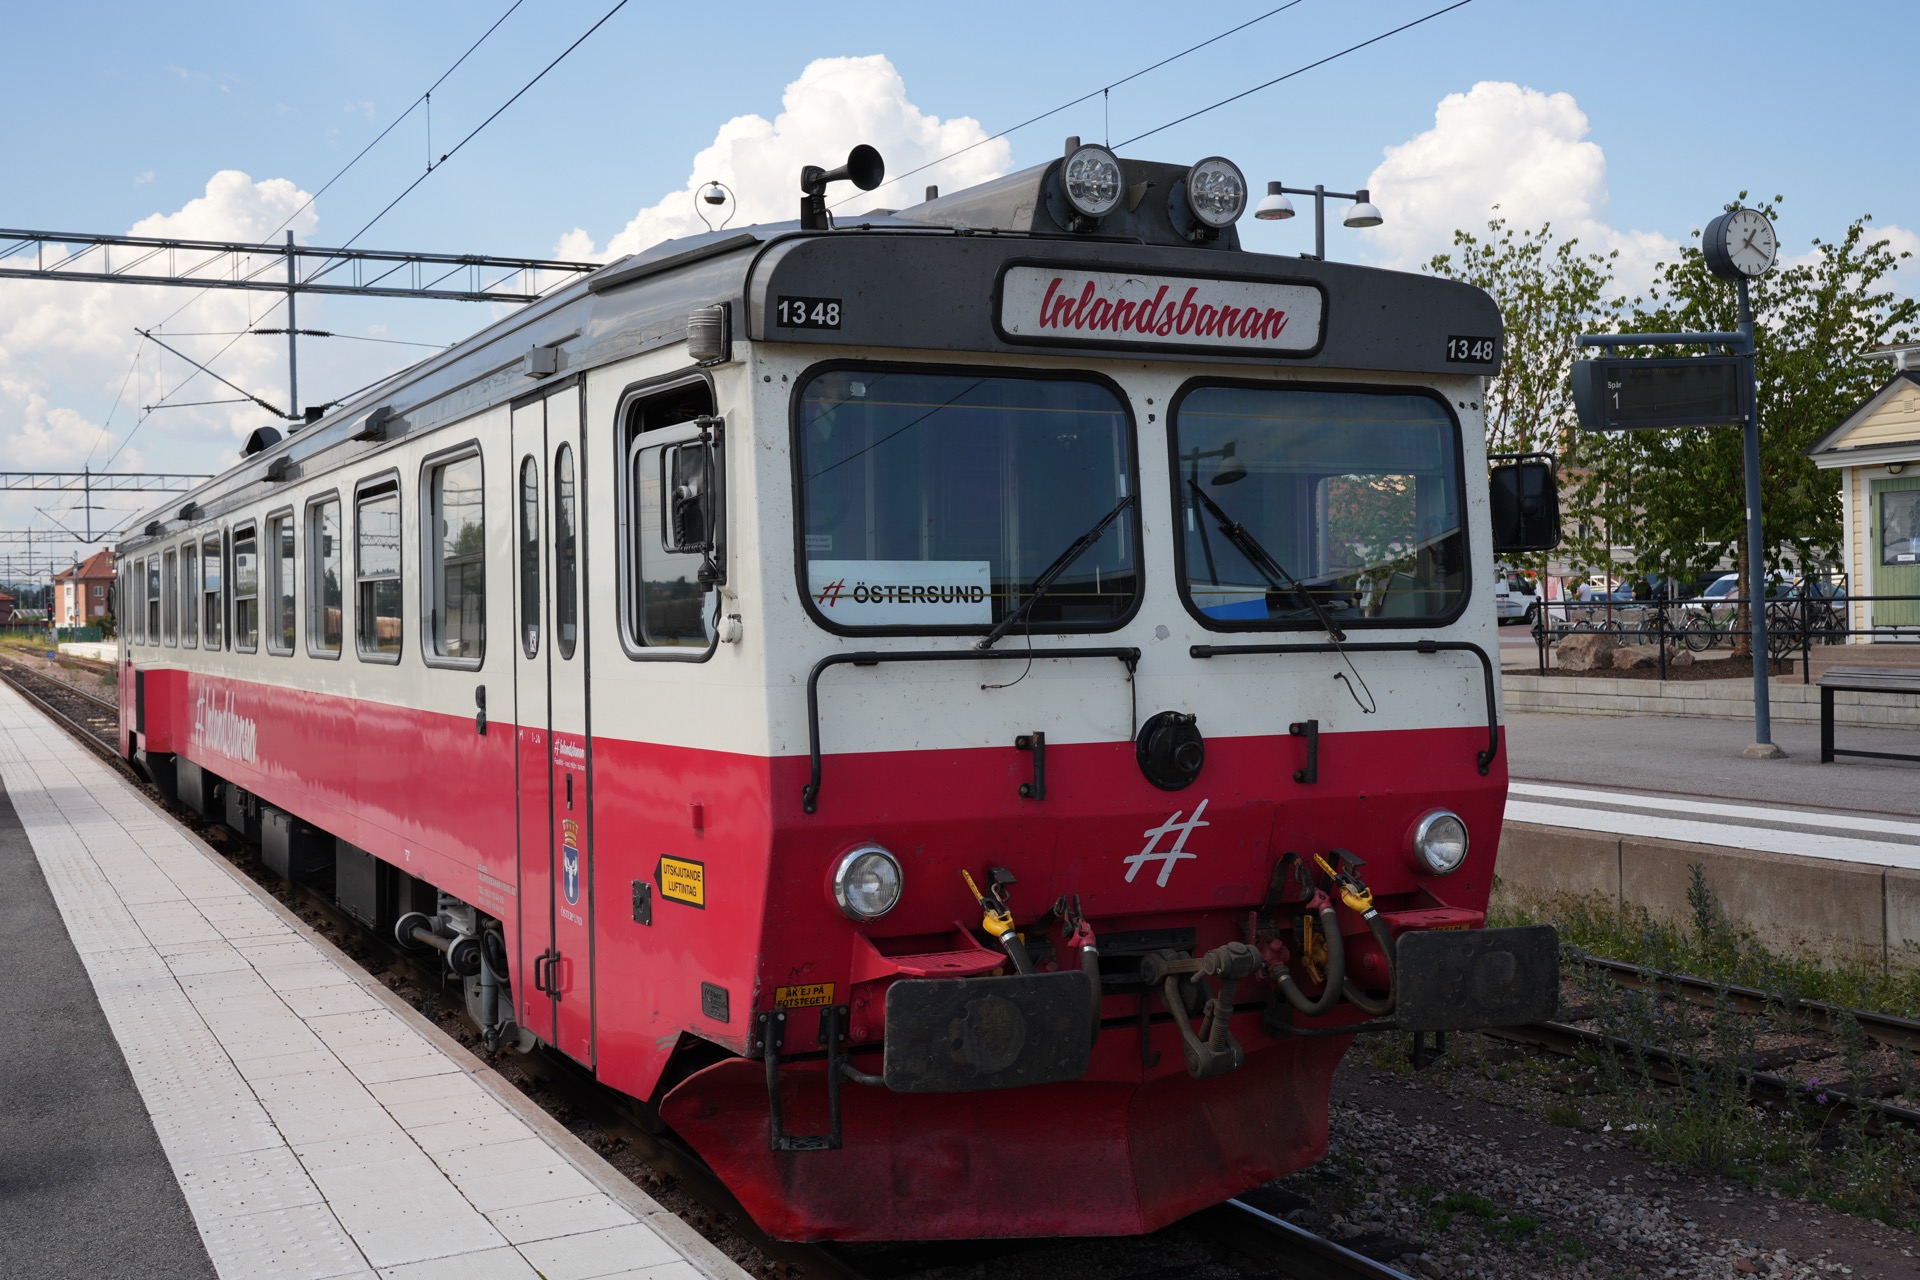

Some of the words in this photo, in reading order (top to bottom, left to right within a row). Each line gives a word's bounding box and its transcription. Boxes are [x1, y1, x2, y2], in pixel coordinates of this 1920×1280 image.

[1039, 277, 1289, 340] Inlandsbanan
[1607, 381, 1622, 390] Spår
[1612, 391, 1619, 410] 1
[853, 581, 984, 604] ÖSTERSUND
[663, 863, 702, 882] UTSKJUTANDE
[668, 880, 697, 897] LUFTINTAG
[801, 987, 811, 996] EJ
[813, 984, 824, 994] PÅ
